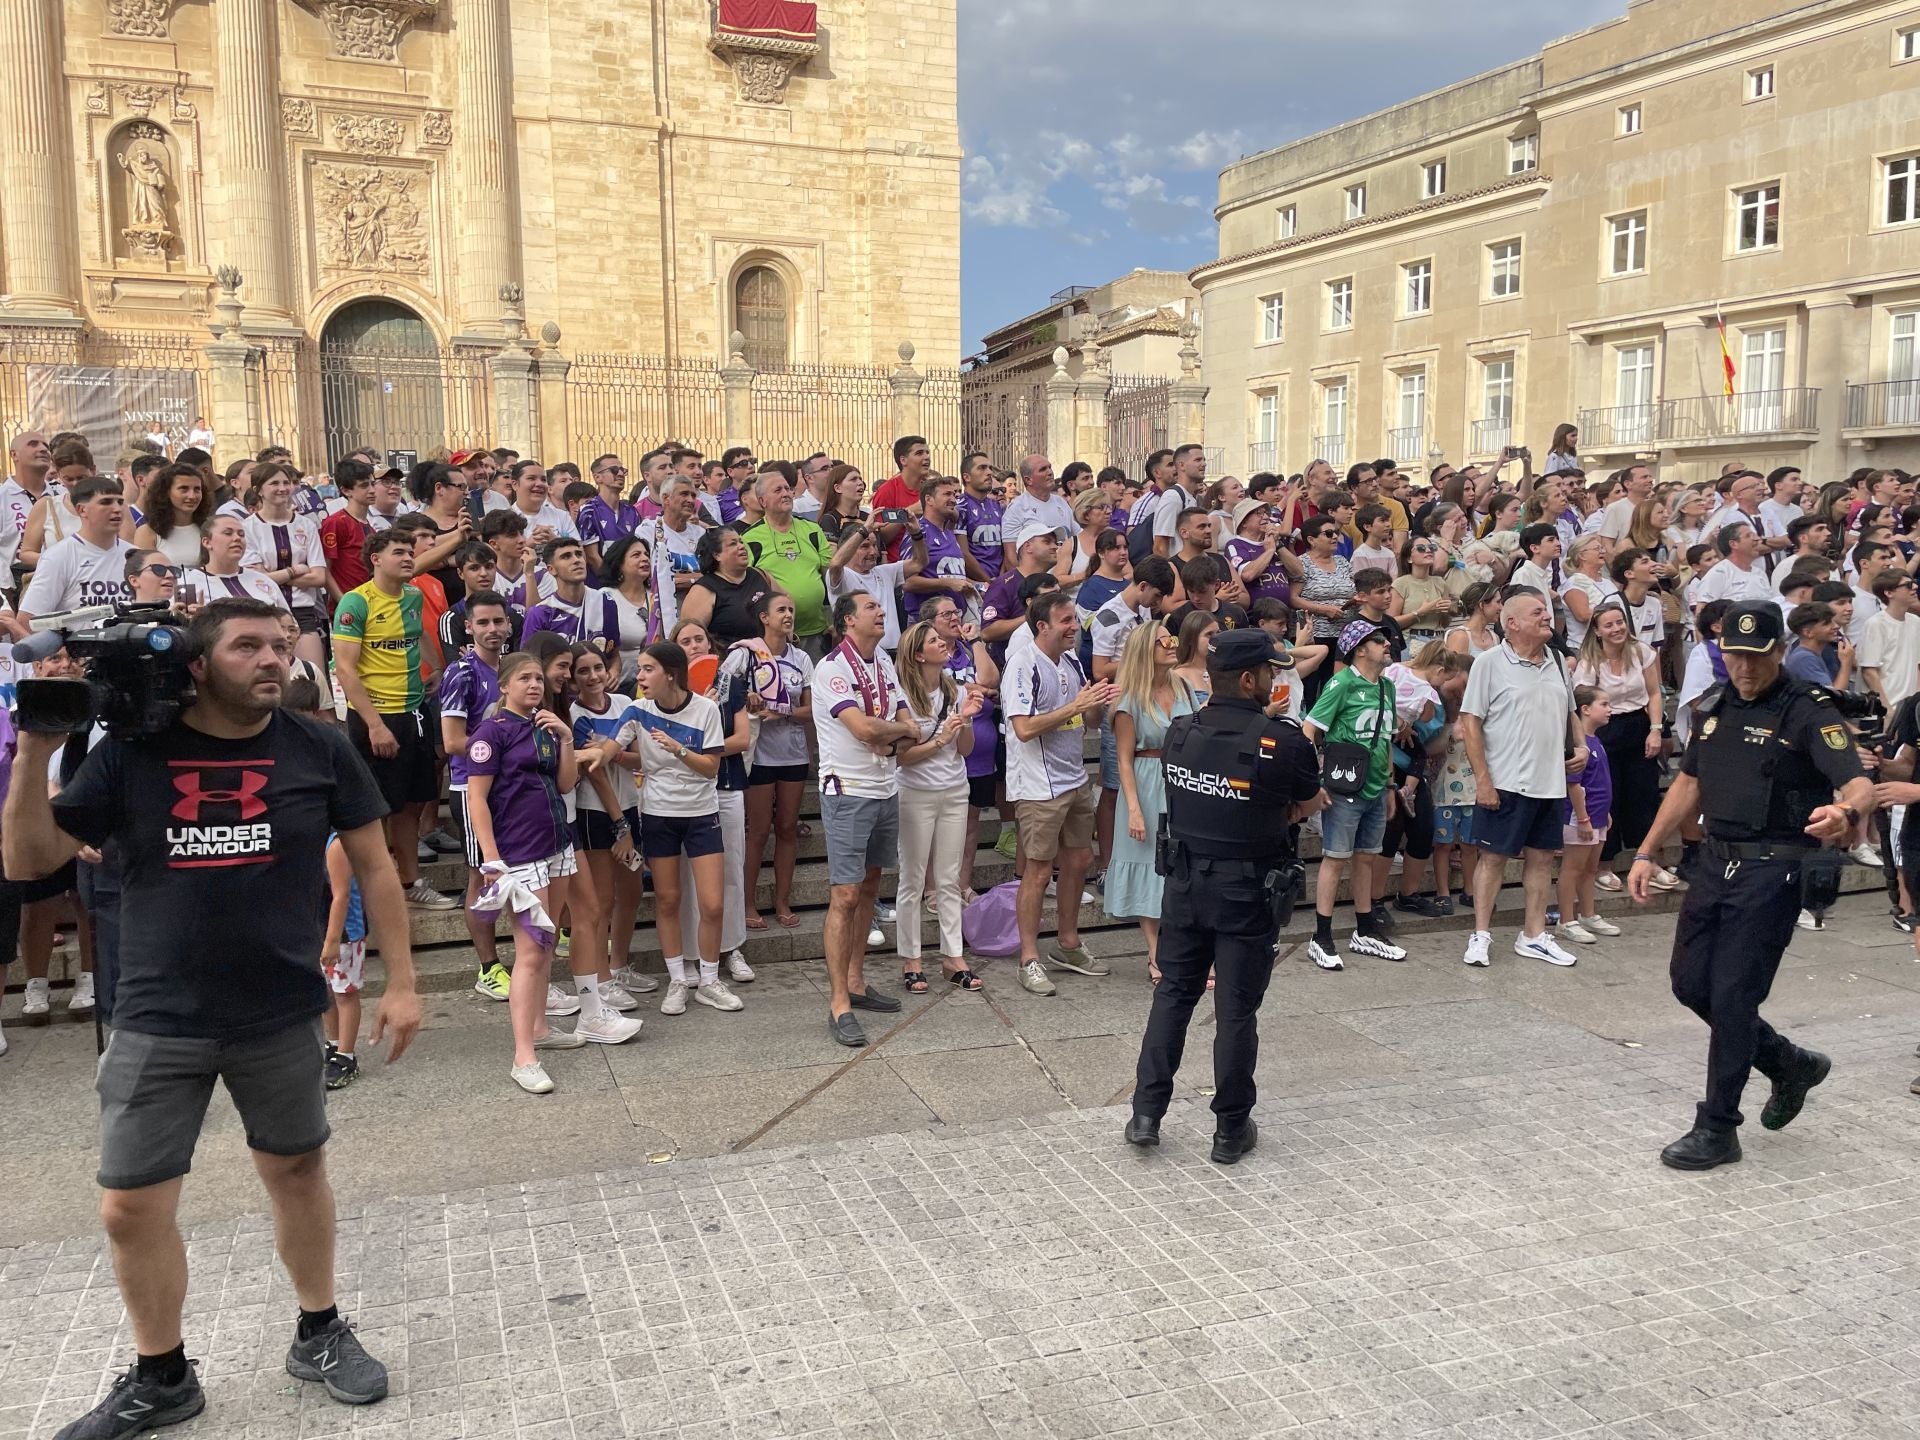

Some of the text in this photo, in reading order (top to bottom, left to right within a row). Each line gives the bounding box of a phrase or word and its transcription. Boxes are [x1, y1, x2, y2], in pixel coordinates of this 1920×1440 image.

[160, 397, 188, 409] THE
[124, 411, 188, 423] MYSTERY
[80, 595, 133, 607] SUMAM
[1166, 763, 1231, 788] POLICÍA
[1167, 774, 1250, 801] NACIONAL
[166, 823, 272, 843] UNDER
[169, 839, 270, 856] ARMOUR
